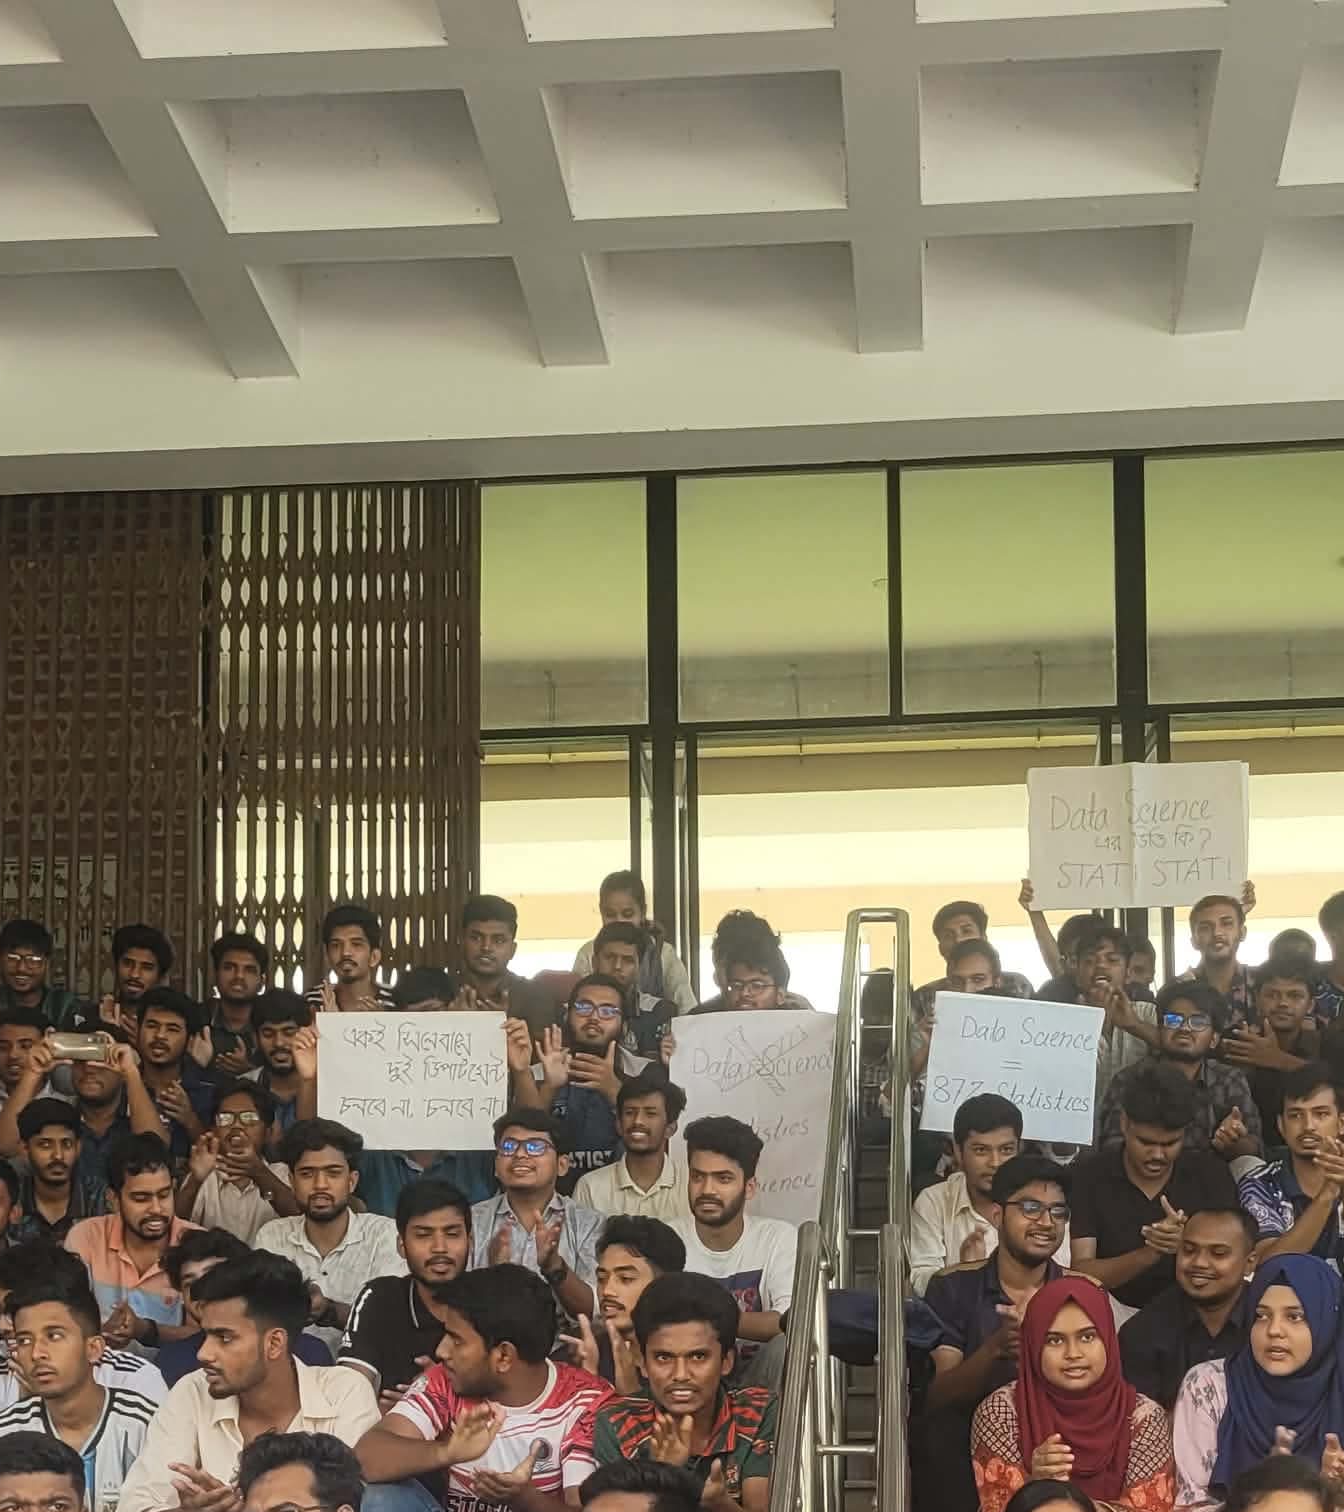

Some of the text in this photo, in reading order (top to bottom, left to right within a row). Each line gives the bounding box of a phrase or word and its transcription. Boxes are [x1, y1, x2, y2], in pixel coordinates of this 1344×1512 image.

[1050, 788, 1212, 832] Data Science
[959, 1014, 1097, 1052] Data Science
